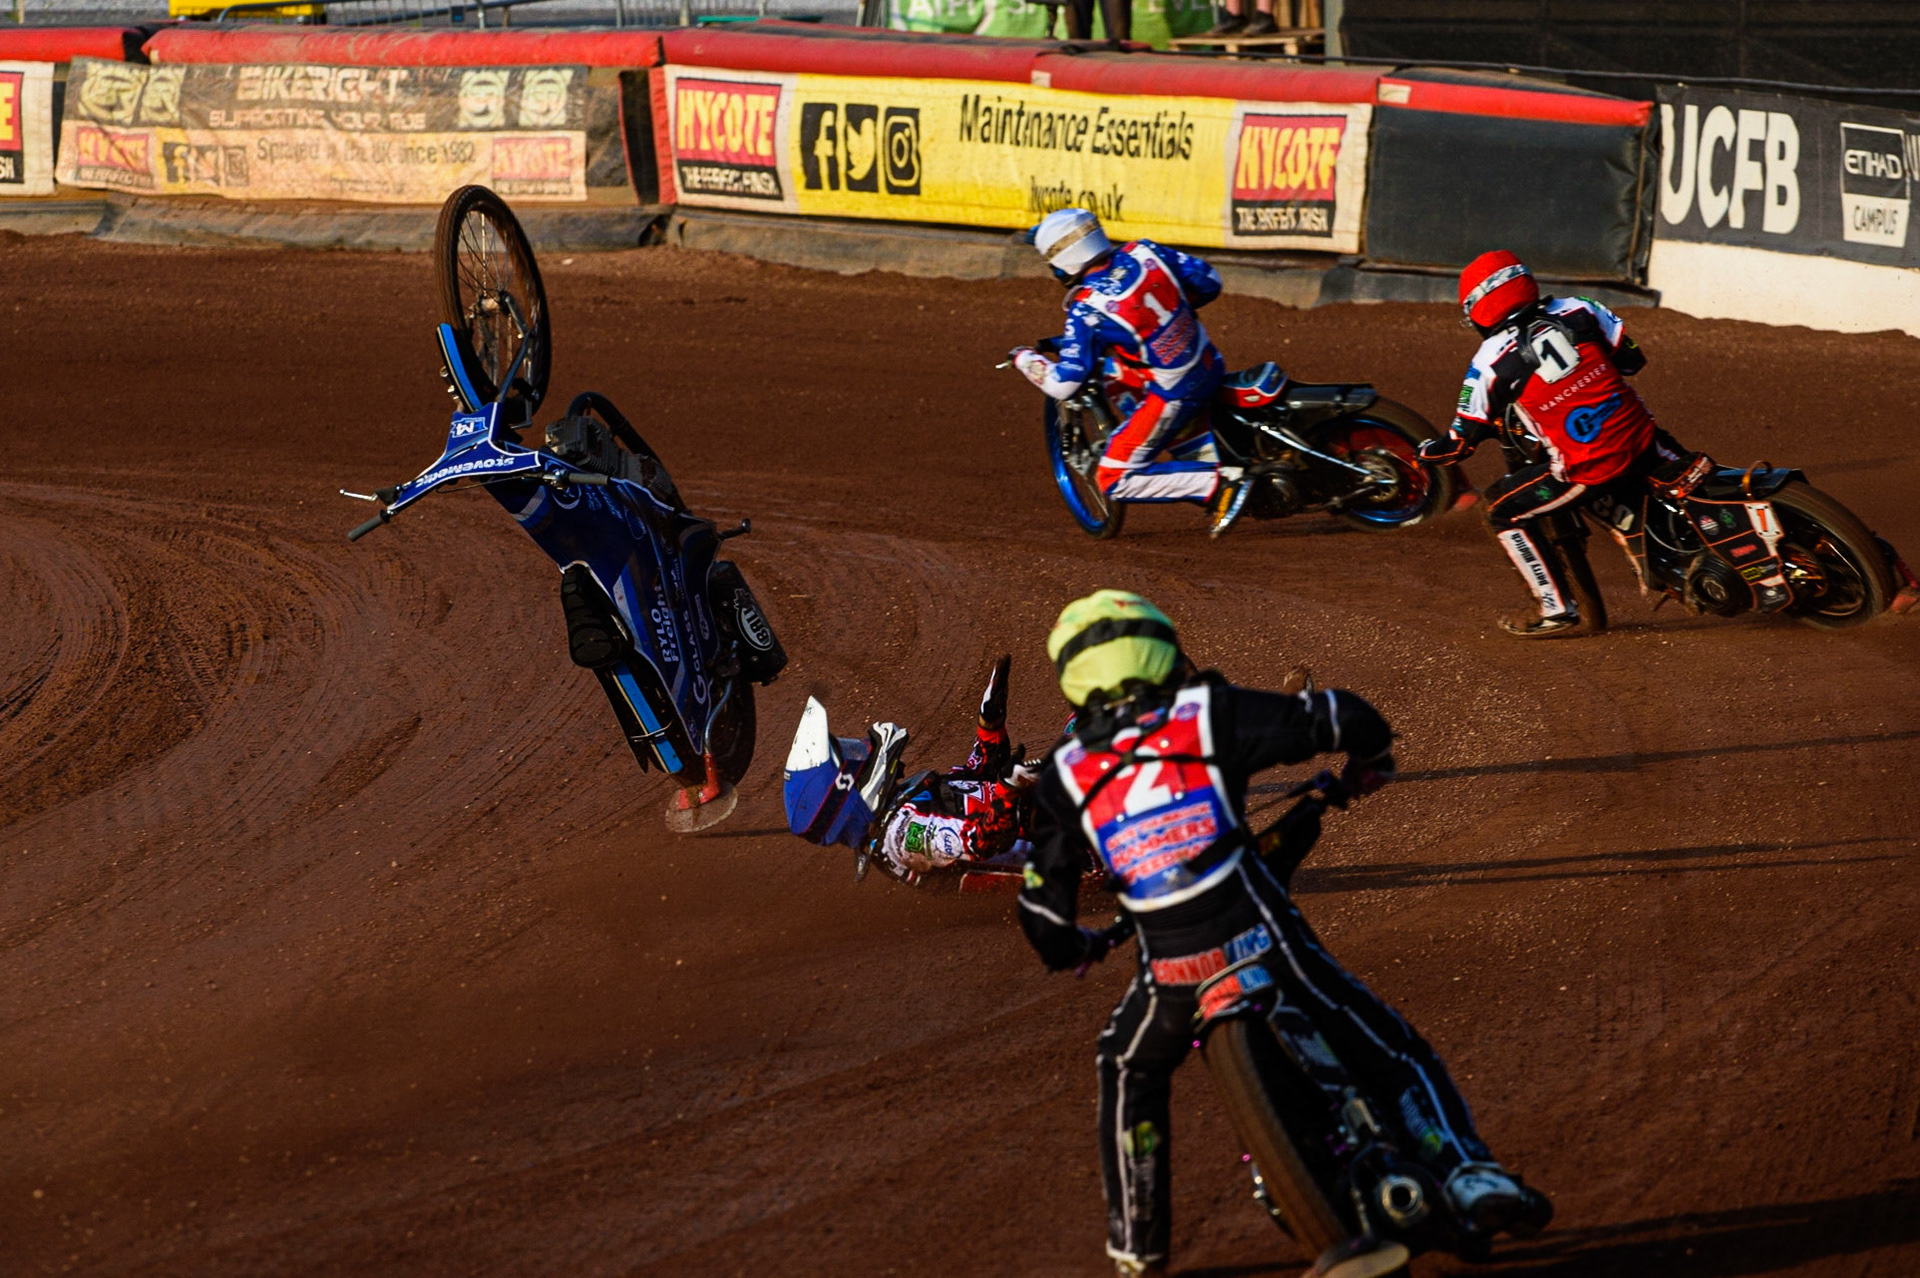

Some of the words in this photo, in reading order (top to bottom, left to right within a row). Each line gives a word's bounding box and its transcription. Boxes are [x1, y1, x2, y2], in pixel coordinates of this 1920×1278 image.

[676, 89, 777, 157] HYCOTE
[1091, 106, 1194, 160] Essentials
[1235, 125, 1341, 191] HYCOTE
[1660, 103, 1801, 235] UCFB
[1844, 148, 1903, 180] ETIHAD
[1539, 338, 1569, 371] 1
[1538, 362, 1608, 413] MANCHESTER
[1757, 508, 1770, 534] 1
[651, 608, 672, 662] RYLO
[1115, 746, 1173, 817] 2
